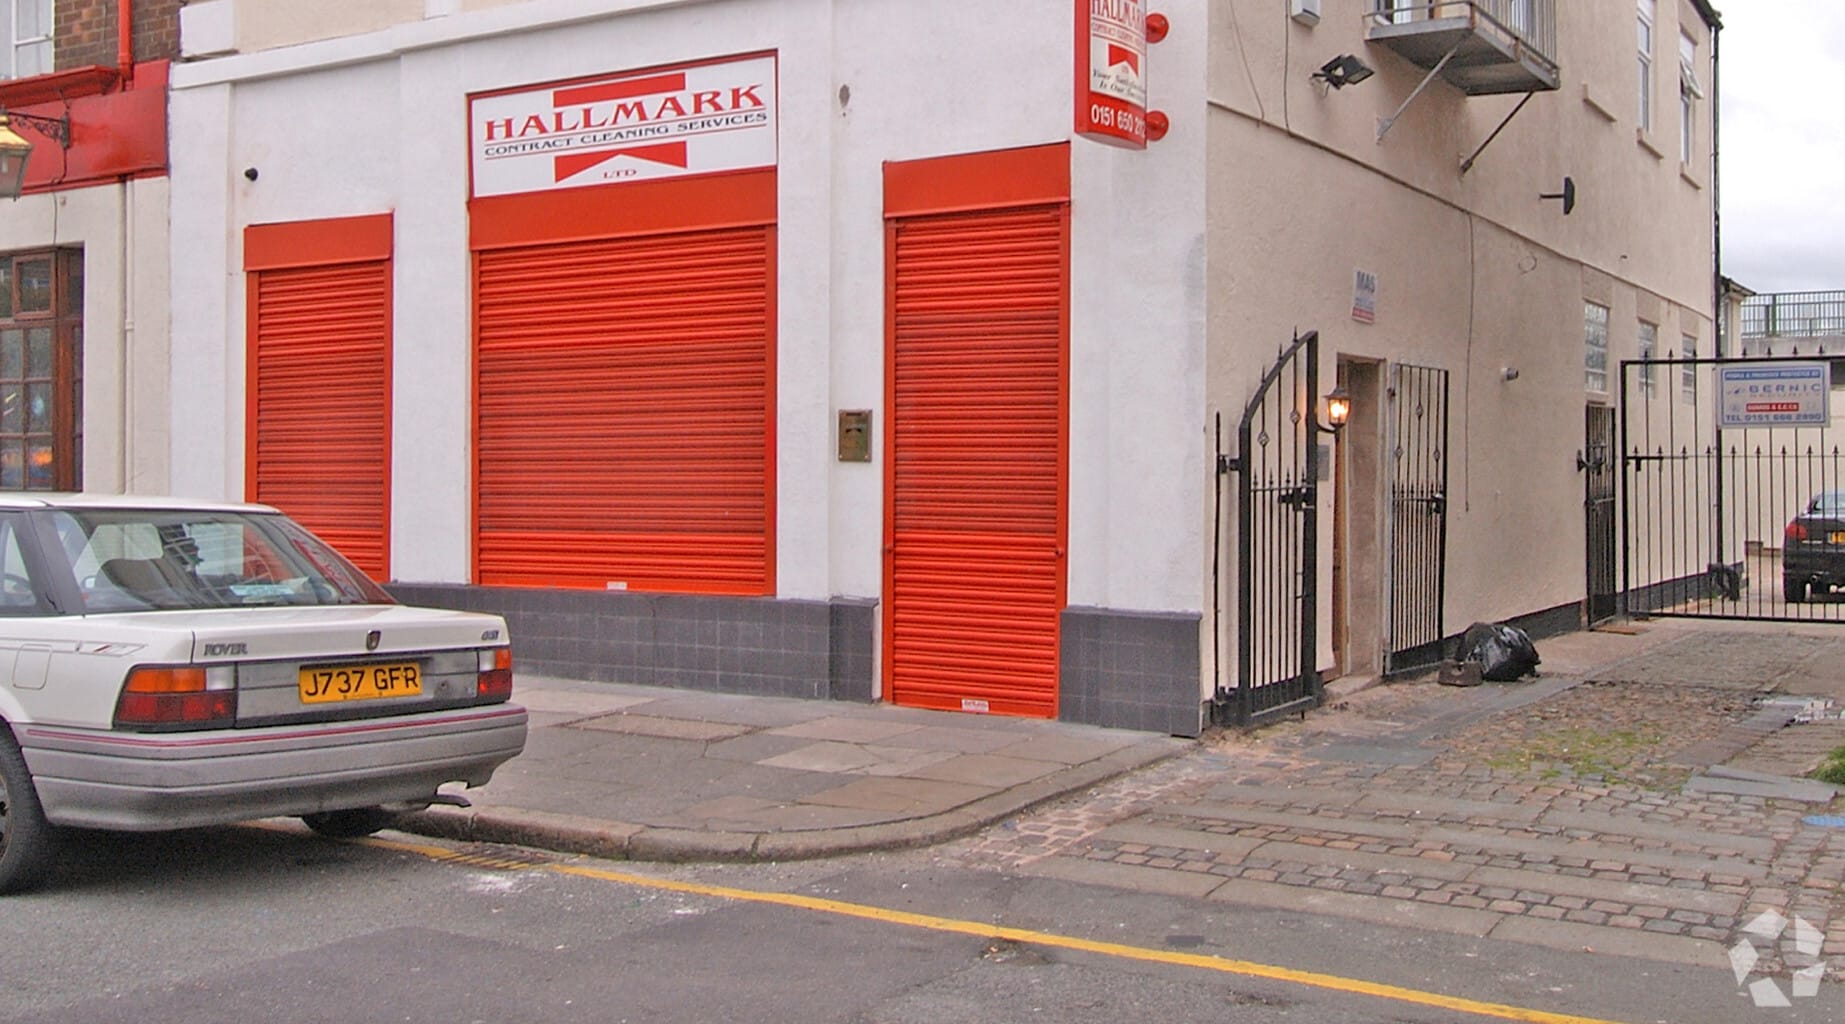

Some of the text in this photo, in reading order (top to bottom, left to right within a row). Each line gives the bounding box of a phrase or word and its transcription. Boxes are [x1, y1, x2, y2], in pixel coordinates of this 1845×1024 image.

[485, 83, 765, 140] HALLMARK
[1091, 104, 1115, 128] 0151
[485, 112, 767, 157] CONTRACT CLEANING SERVICES
[603, 168, 637, 179] LTD
[1749, 383, 1821, 393] BERNIC
[203, 642, 248, 657] ROVER
[305, 666, 419, 696] J737 GFR
